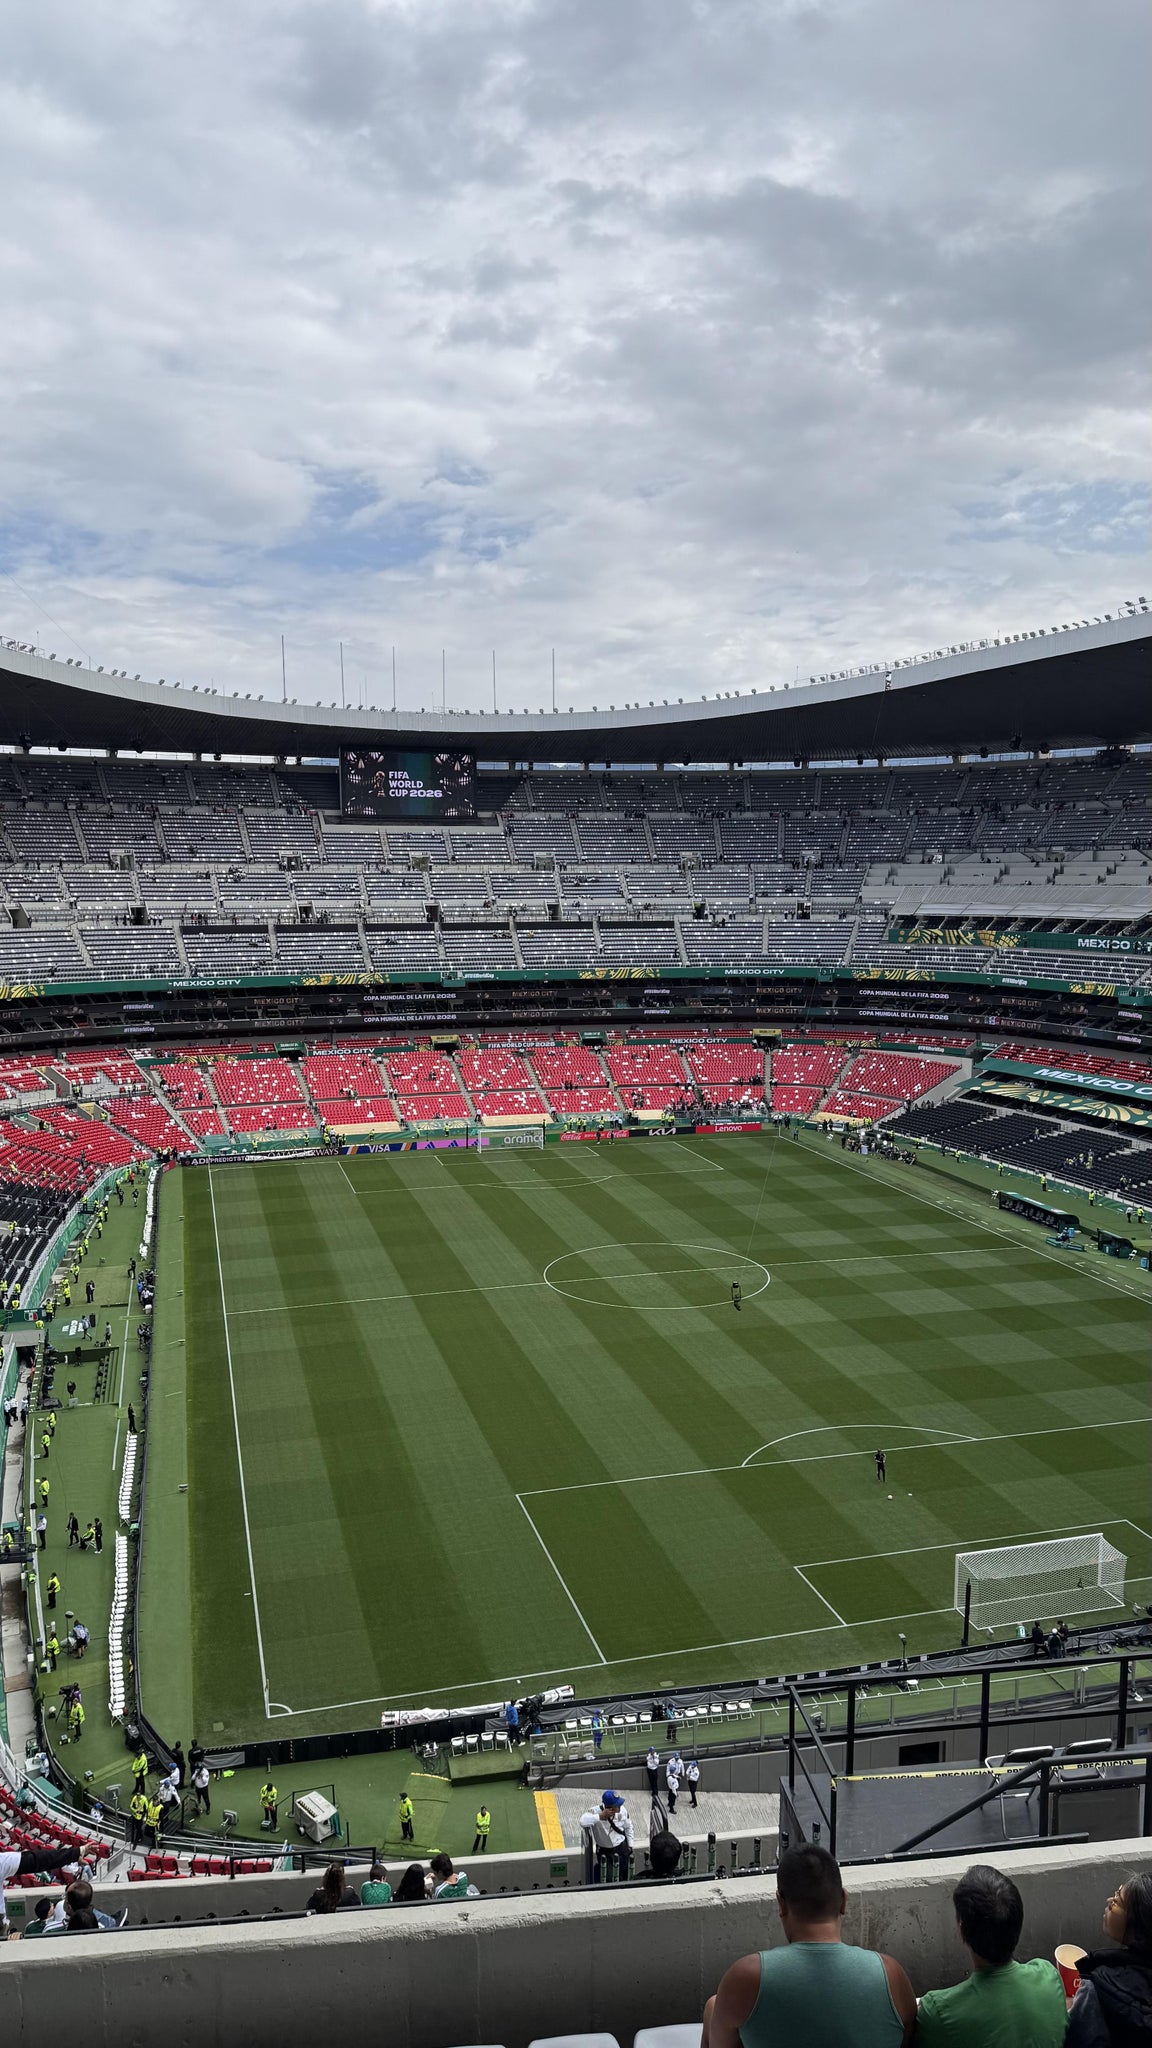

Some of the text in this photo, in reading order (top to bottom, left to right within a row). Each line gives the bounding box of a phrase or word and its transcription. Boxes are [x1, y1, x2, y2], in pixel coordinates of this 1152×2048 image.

[389, 771, 409, 779] FIFA
[389, 780, 423, 788] WORLD
[389, 789, 443, 797] CUP 2026
[1078, 938, 1130, 950] MEXICO
[1034, 1067, 1134, 1091] MEXICO
[649, 1127, 676, 1136] KIA
[715, 1124, 743, 1132] Lenovo
[503, 1134, 545, 1144] aramco
[368, 1143, 391, 1153] VISA
[210, 1155, 247, 1163] PREDICTST
